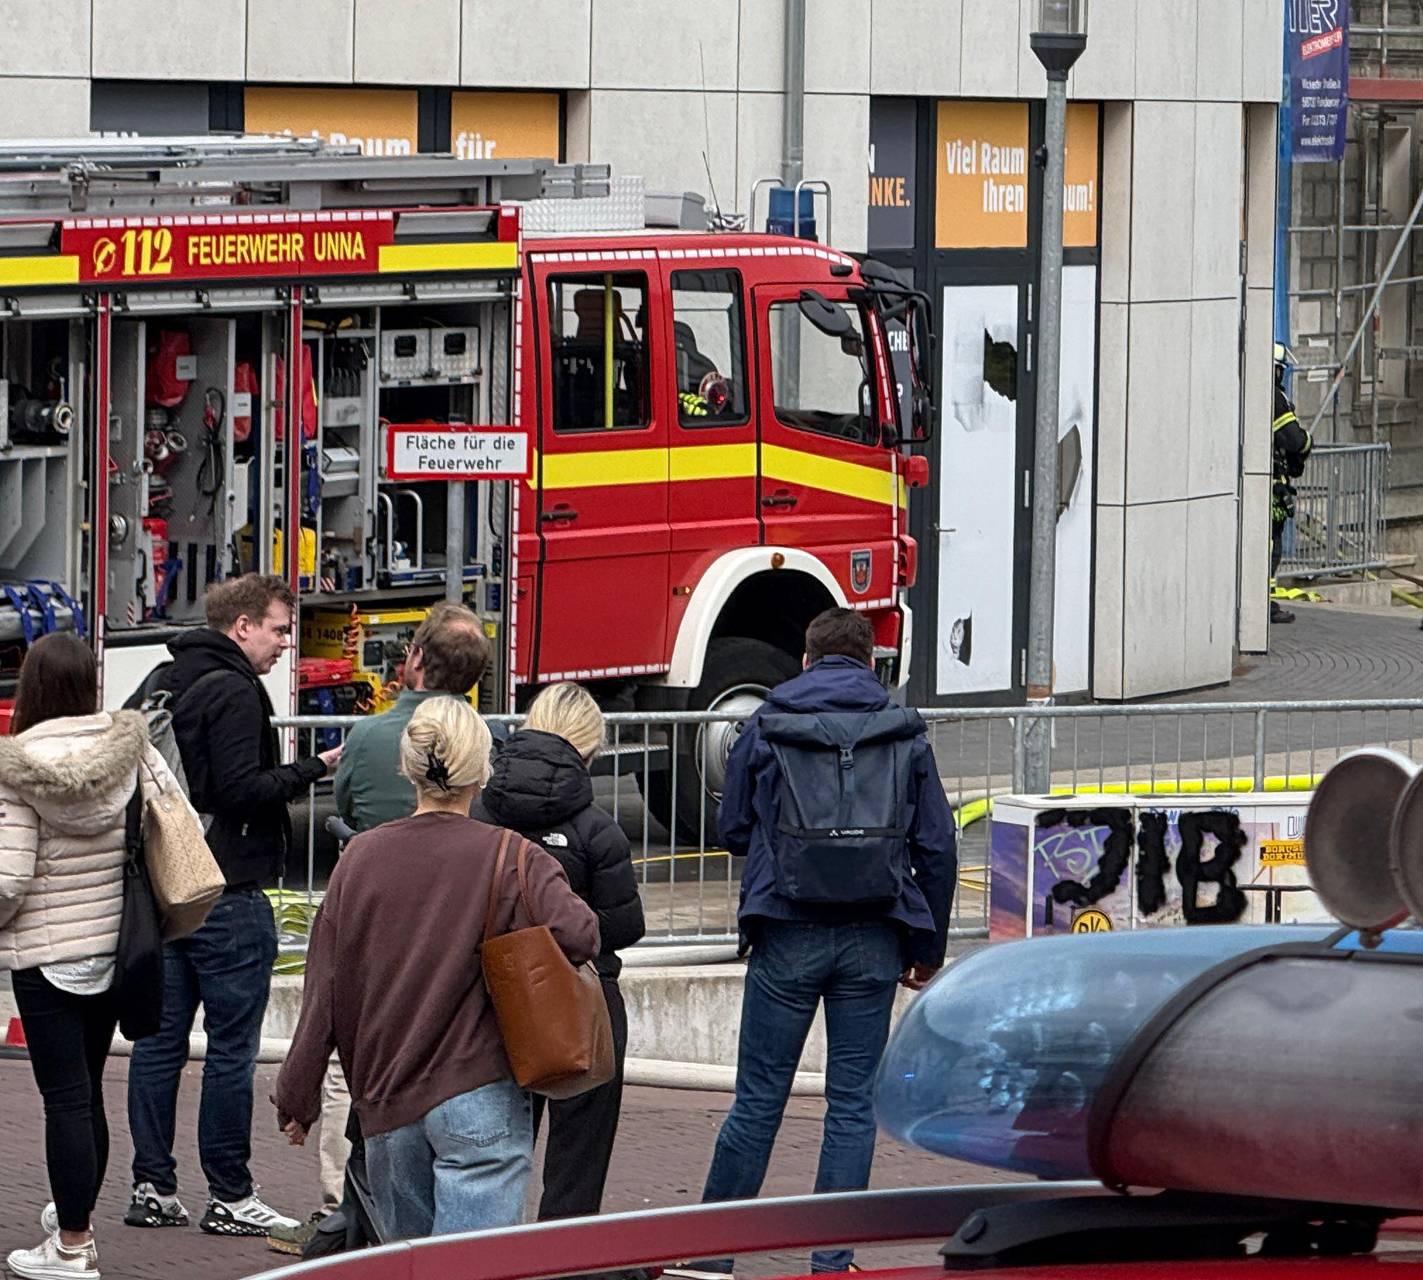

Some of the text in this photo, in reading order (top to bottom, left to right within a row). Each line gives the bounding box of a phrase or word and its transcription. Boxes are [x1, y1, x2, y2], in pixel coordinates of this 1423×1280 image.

[946, 140, 1025, 175] Viel Raum
[983, 177, 1024, 213] Ihren
[121, 228, 366, 276] 112 FEUERWEHR UNNA
[406, 435, 516, 450] Fläche für die
[418, 456, 503, 470] Feuerwehr
